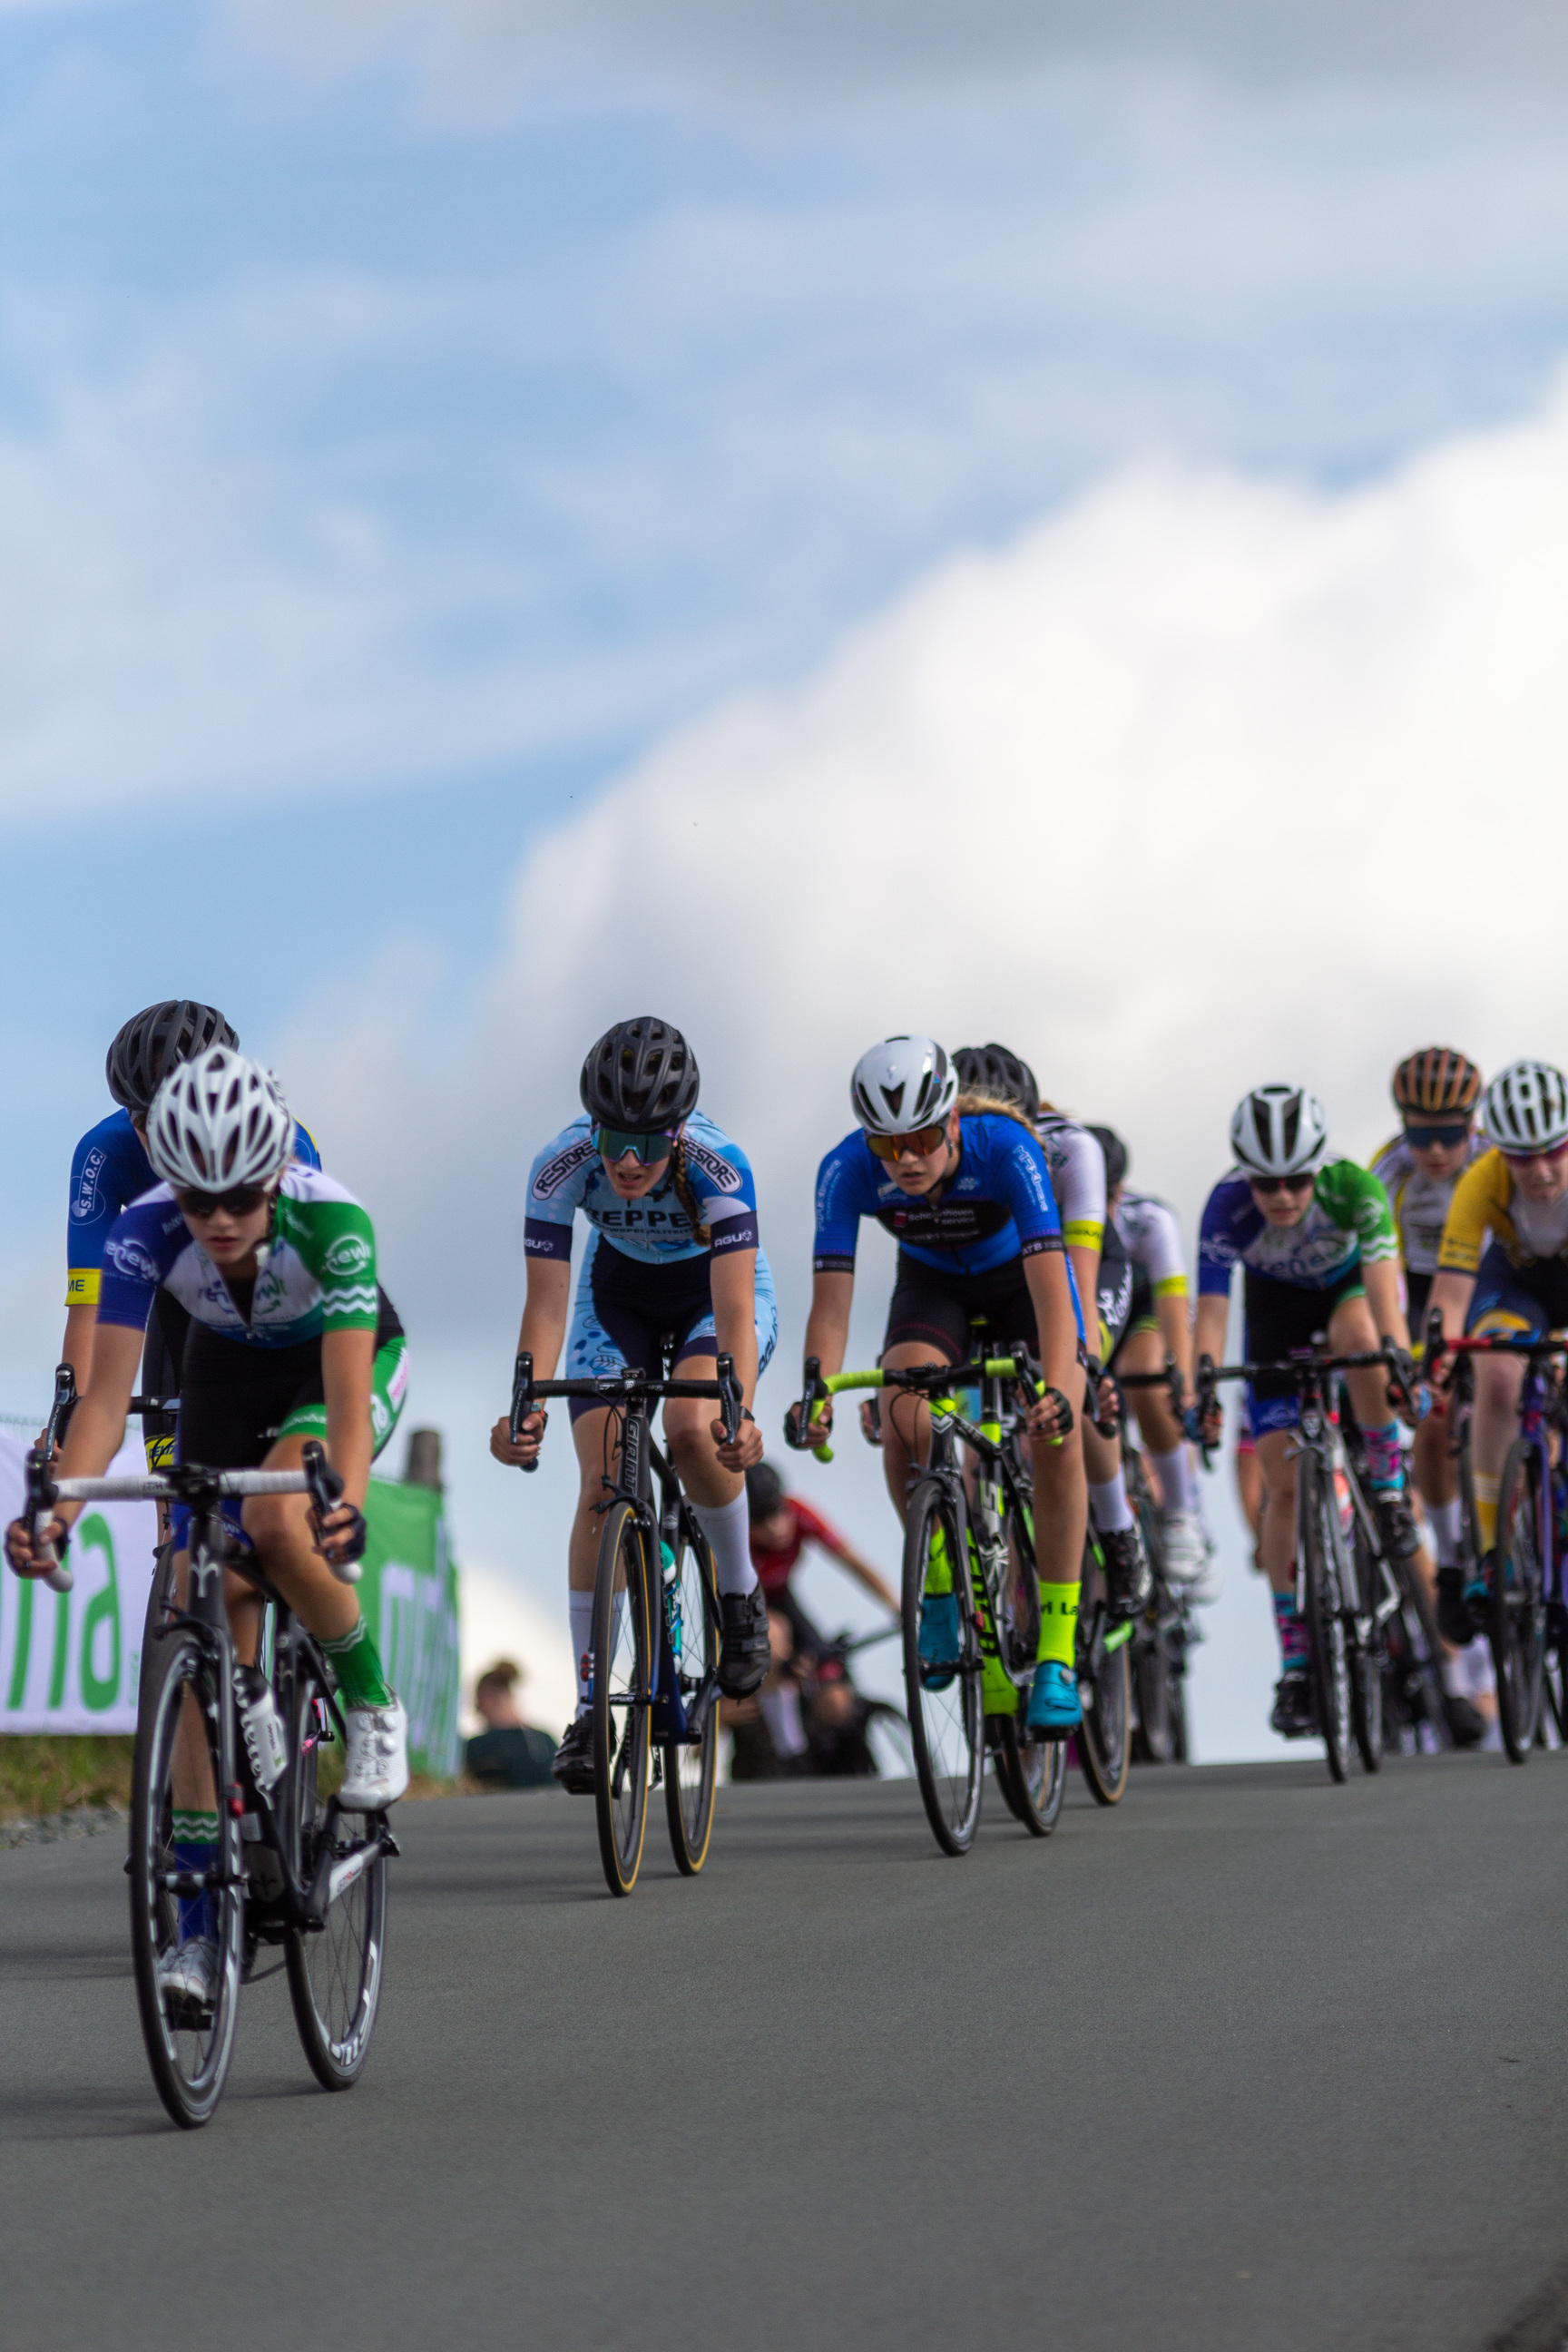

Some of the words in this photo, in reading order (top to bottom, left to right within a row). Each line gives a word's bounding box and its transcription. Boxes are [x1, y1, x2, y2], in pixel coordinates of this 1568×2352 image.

[81, 1153, 103, 1210] S.W.O.C.
[535, 1142, 597, 1193] RESTORE
[714, 1232, 743, 1249] AGU
[1022, 1243, 1043, 1257] ATB
[624, 1416, 640, 1495] GIANT
